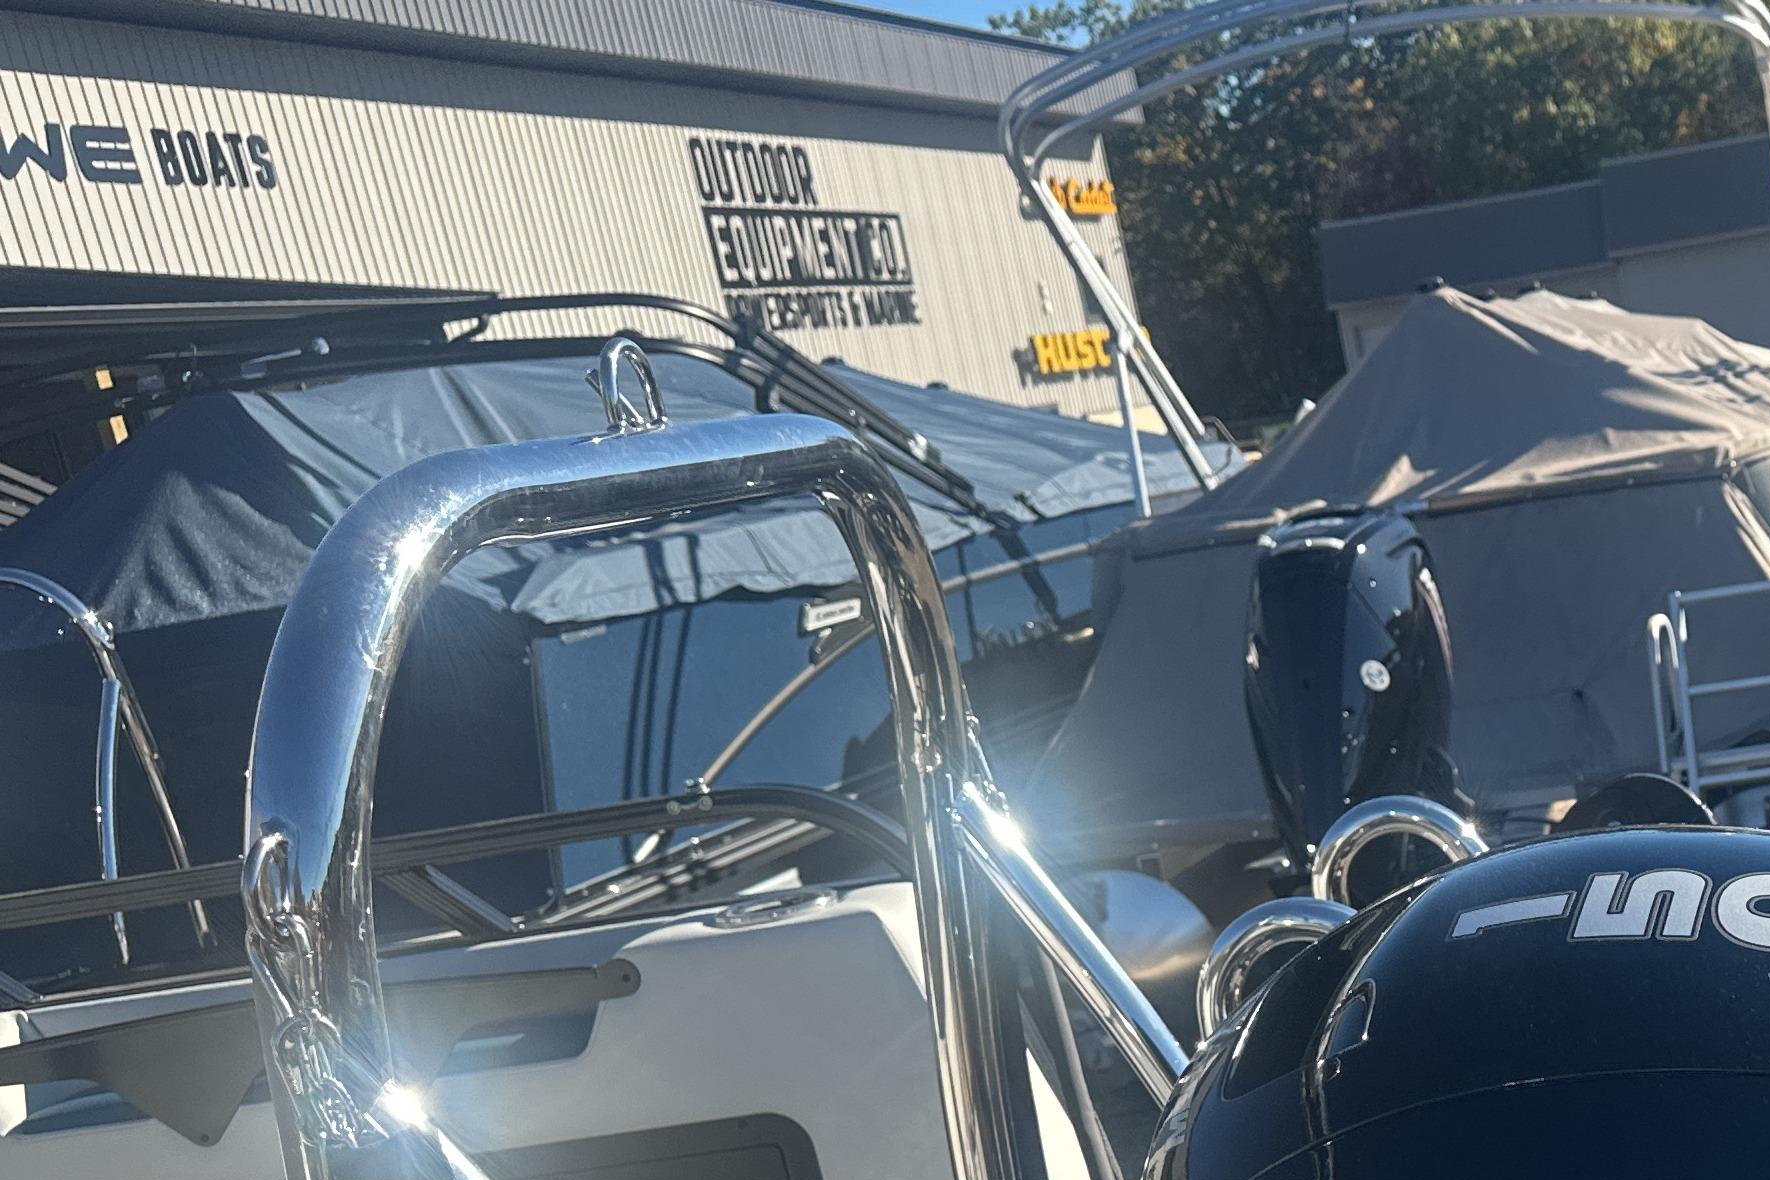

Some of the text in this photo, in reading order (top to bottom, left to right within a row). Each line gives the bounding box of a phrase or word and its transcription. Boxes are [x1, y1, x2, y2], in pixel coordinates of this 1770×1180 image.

[150, 128, 276, 189] BOATS
[689, 138, 818, 206] OUTDOOR
[709, 213, 864, 285] EQUIPMENT
[1031, 327, 1151, 374] HUST
